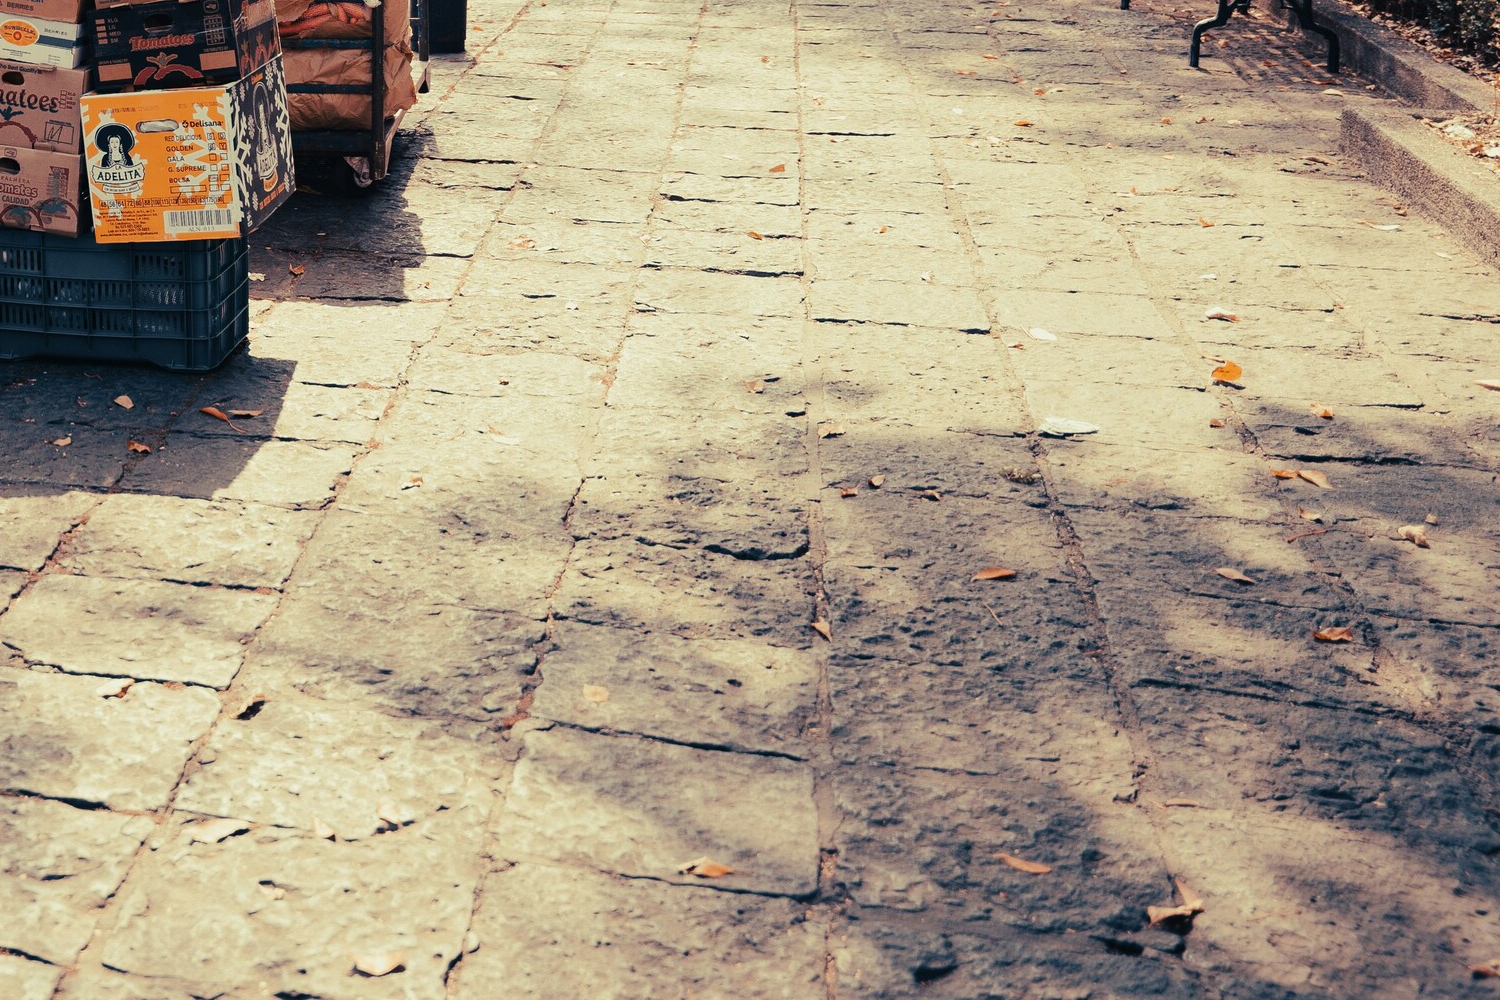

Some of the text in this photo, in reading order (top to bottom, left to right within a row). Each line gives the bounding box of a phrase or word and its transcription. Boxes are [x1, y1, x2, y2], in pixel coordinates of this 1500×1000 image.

[6, 1, 34, 12] BERRIES
[44, 28, 68, 36] BERRIES
[129, 33, 195, 51] Tomatoes
[190, 120, 222, 128] Delisana
[0, 176, 30, 184] PALMERA
[97, 170, 141, 181] ADELITA
[2, 195, 29, 205] CALIDAD
